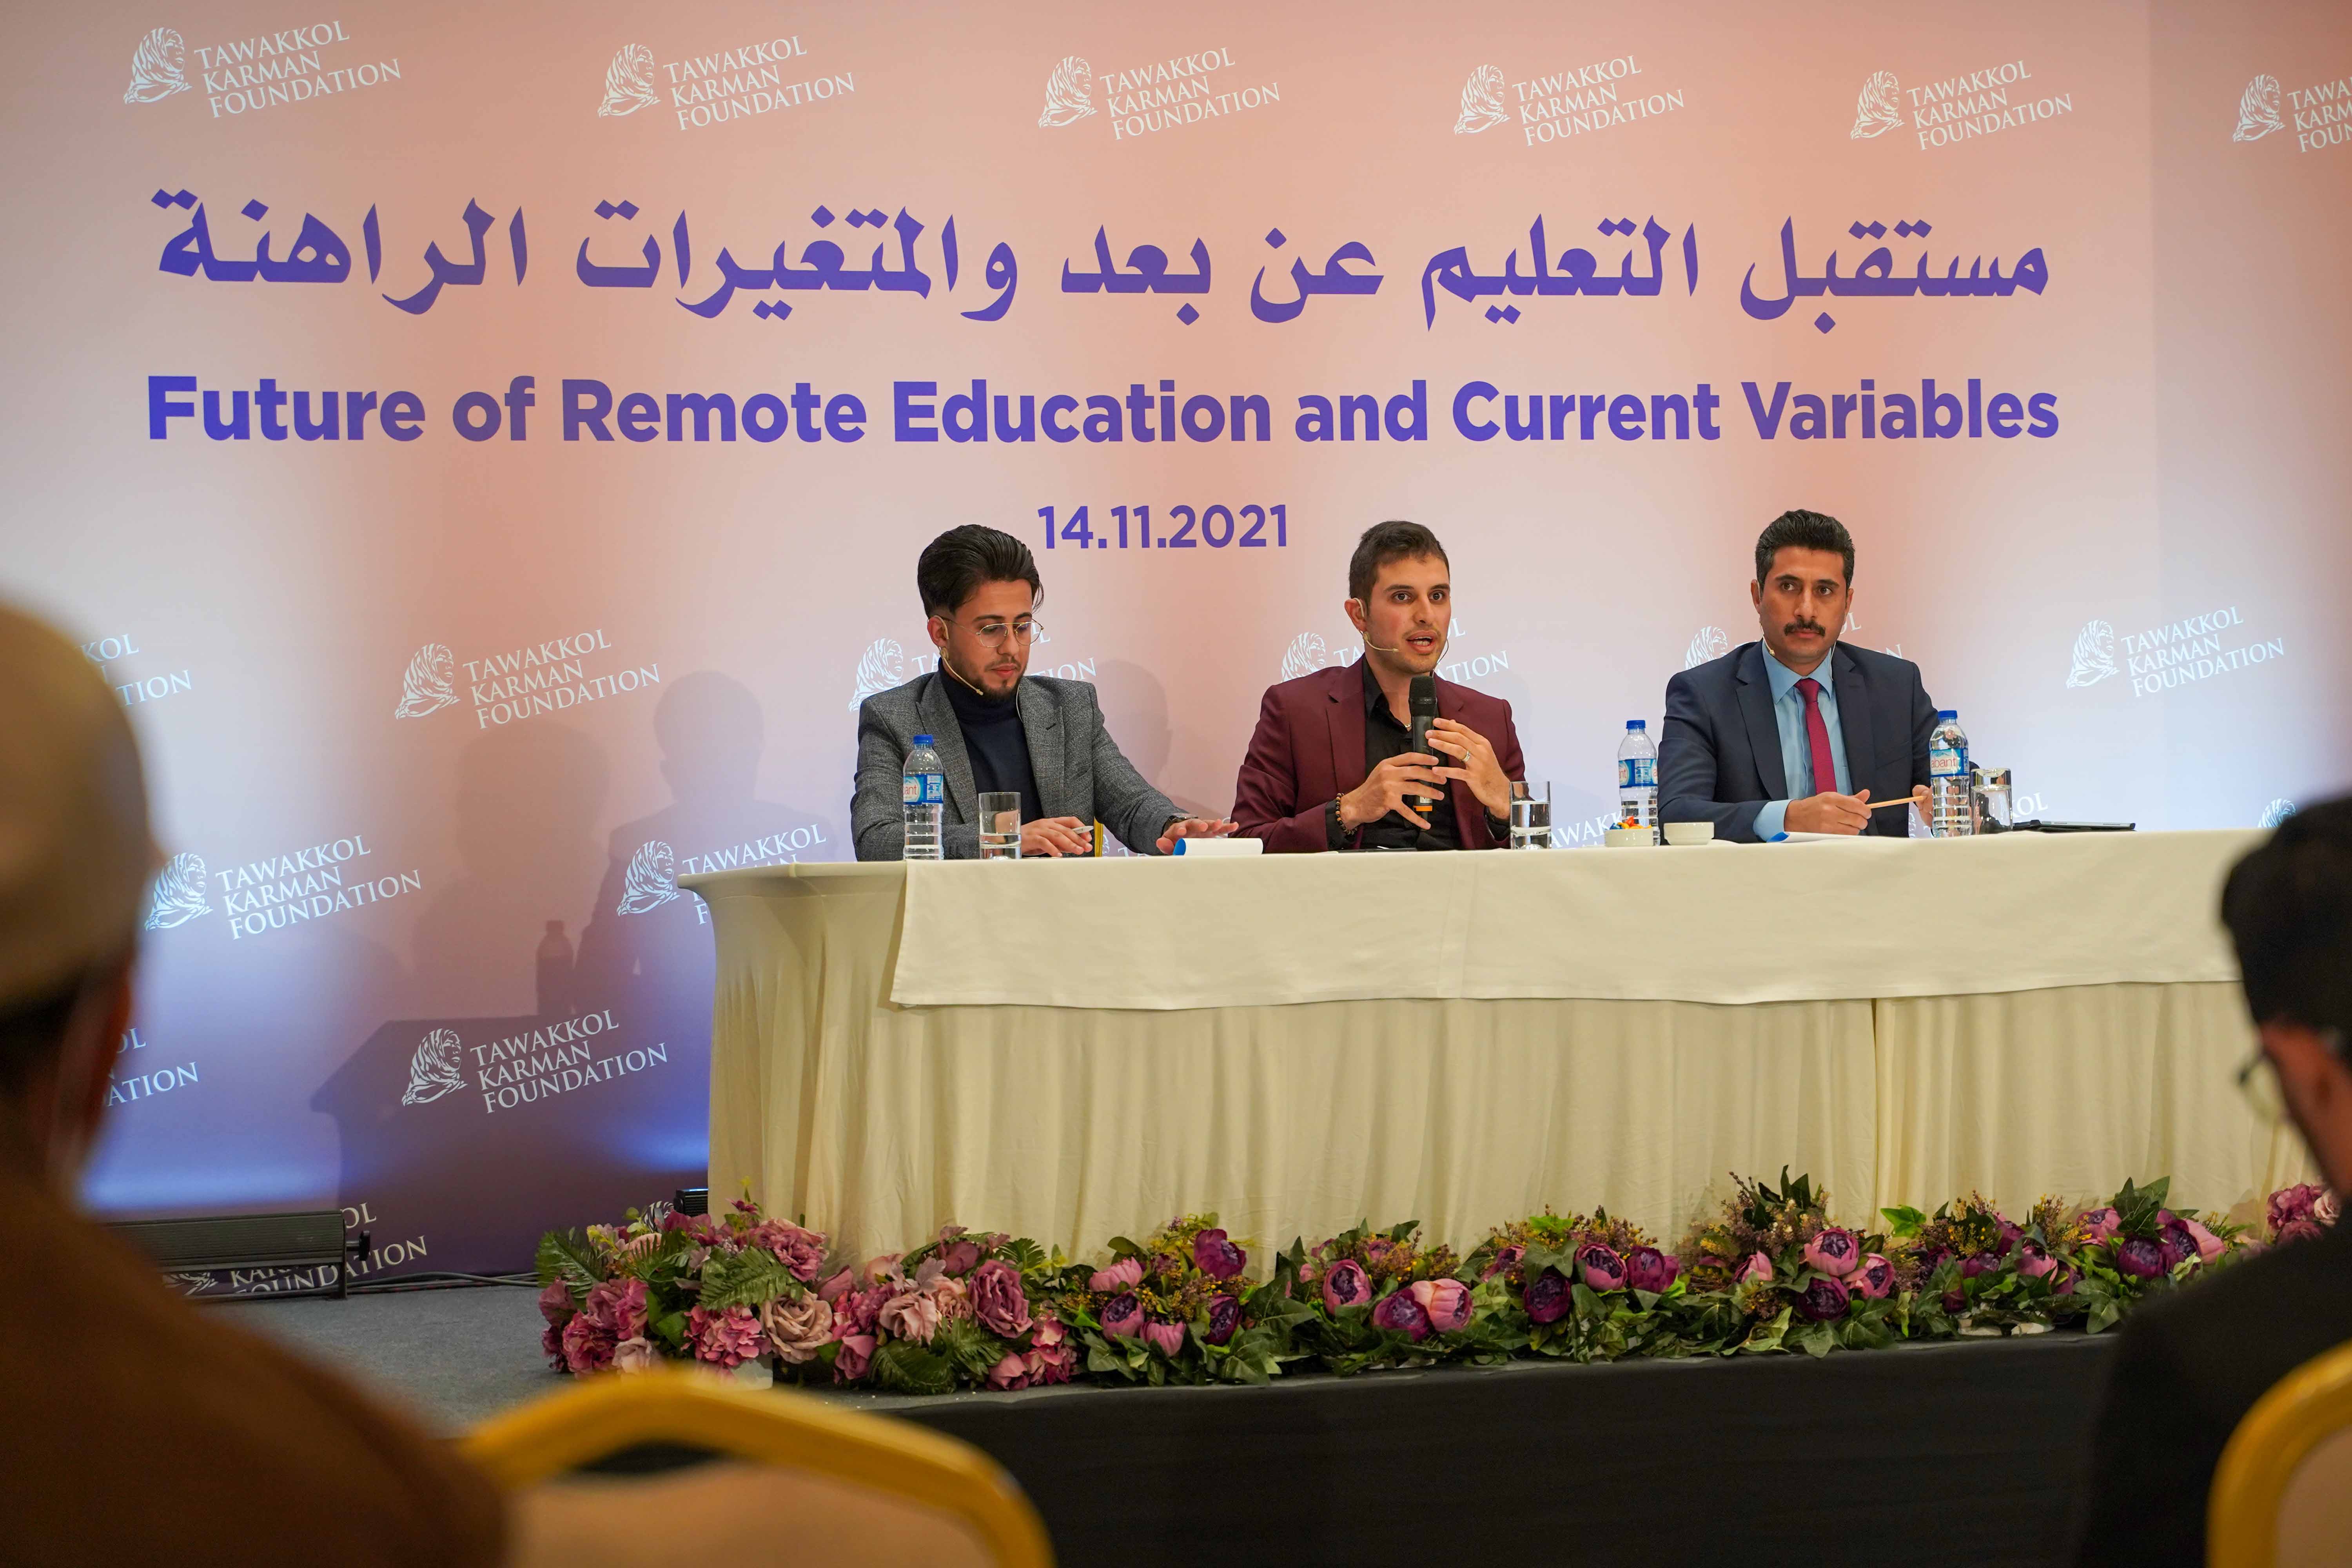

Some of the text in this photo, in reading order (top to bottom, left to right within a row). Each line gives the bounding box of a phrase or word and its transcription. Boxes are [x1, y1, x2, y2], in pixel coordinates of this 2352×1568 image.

[194, 20, 350, 69] TAWAKKOL
[663, 36, 807, 83] TAWAKKOL
[202, 50, 320, 94] KARMAN
[209, 58, 401, 118] FOUNDATION
[670, 64, 780, 107] KARMAN
[1099, 47, 1236, 94] TAWAKKOL
[1512, 55, 1642, 102] TAWAKKOL
[1906, 60, 2031, 107] TAWAKKOL
[2287, 77, 2352, 110] TAWA
[676, 72, 854, 131] FOUNDATION
[1106, 75, 1210, 118] KARMAN
[1111, 82, 1280, 140] FOUNDATION
[1518, 83, 1617, 125] KARMAN
[1524, 89, 1684, 146] FOUNDATION
[1913, 87, 2007, 129] KARMAN
[2293, 99, 2352, 132] KARM
[1918, 93, 2072, 151] FOUNDATION
[151, 189, 2048, 333] مستقبل التعليم عن بعد والمتغيرات الراهنة
[147, 375, 2059, 443] Future of Remote Education and Current Variables
[1038, 505, 1286, 549] 14.11.2021
[2121, 606, 2244, 655] TAWAKKOL
[2127, 633, 2220, 677] KARMAN
[463, 629, 611, 682] TAWAKKOL
[2132, 637, 2284, 697] FOUNDATION
[471, 659, 583, 706] KARMAN
[476, 663, 660, 729] FOUNDATION
[1931, 756, 1957, 768] abant
[903, 784, 917, 795] ant
[682, 823, 826, 875] TAWAKKOL
[1551, 810, 1622, 848] AWAKK
[215, 835, 371, 891] TAWAKKOL
[223, 866, 341, 916] KARMAN
[229, 869, 421, 940] FOUNDATION
[470, 1009, 619, 1067] TAWAKKOL
[107, 1061, 199, 1107] ATION
[477, 1040, 591, 1091] KARMAN
[483, 1042, 667, 1114] FOUNDATION
